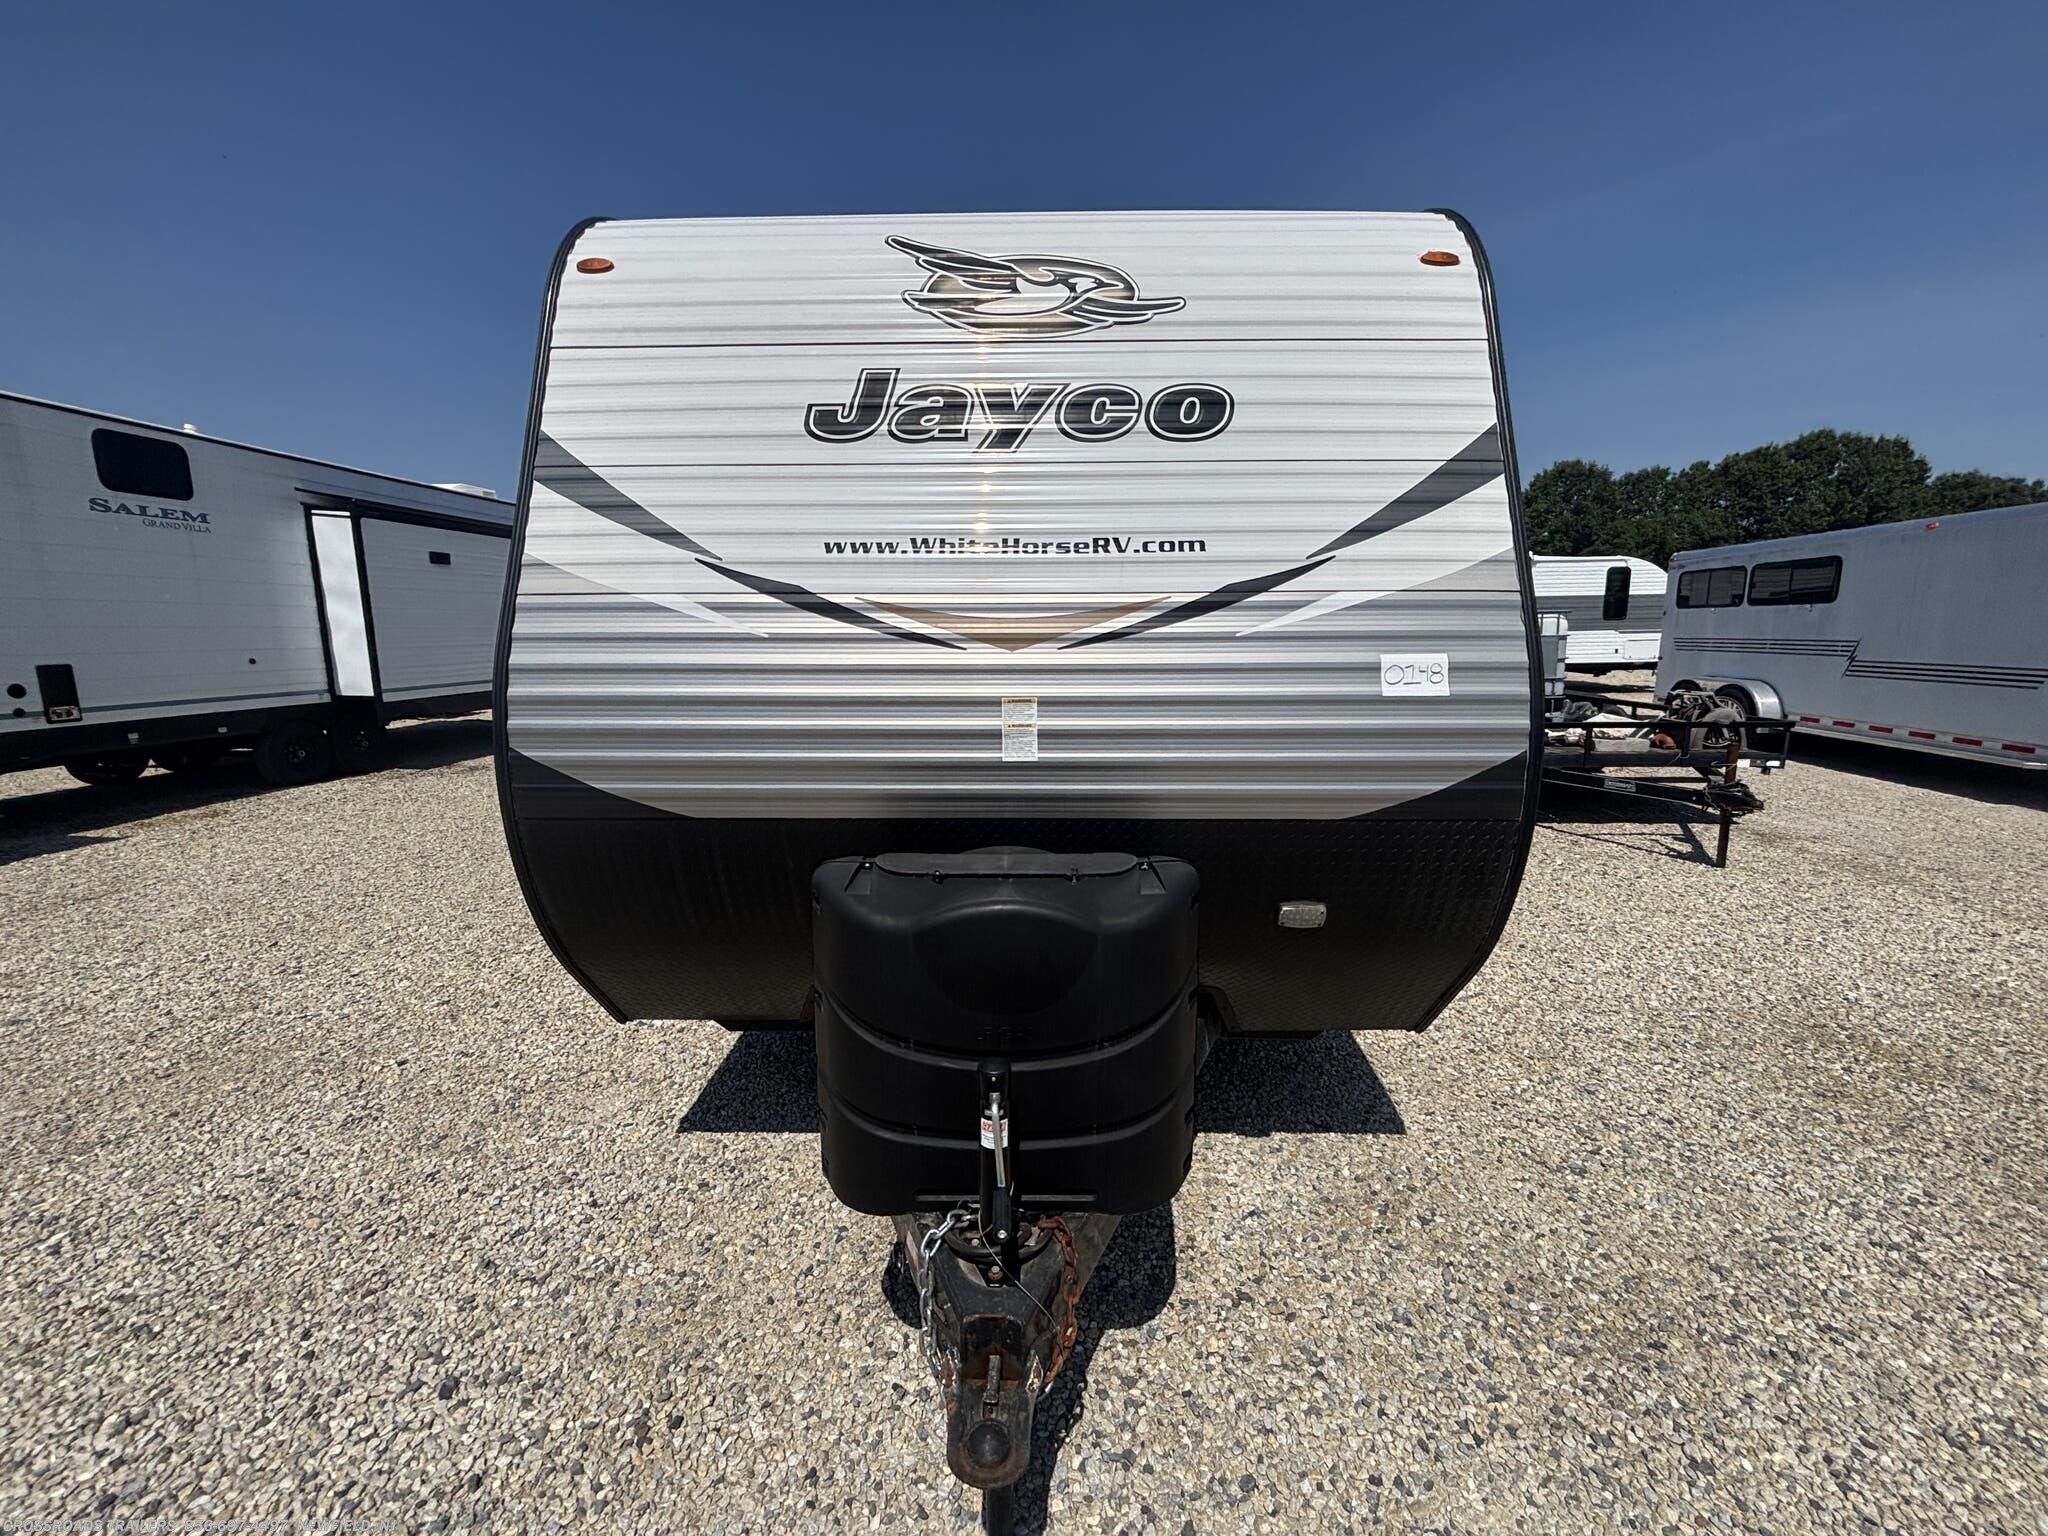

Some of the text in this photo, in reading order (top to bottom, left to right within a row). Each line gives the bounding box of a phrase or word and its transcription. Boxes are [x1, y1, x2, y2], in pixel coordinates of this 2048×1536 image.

[804, 368, 1235, 453] Jayco
[88, 497, 210, 524] SALEM
[142, 517, 212, 534] GRAND VILLA
[823, 537, 1207, 555] www.WhiteHorseRV.com
[1384, 662, 1445, 686] 0148
